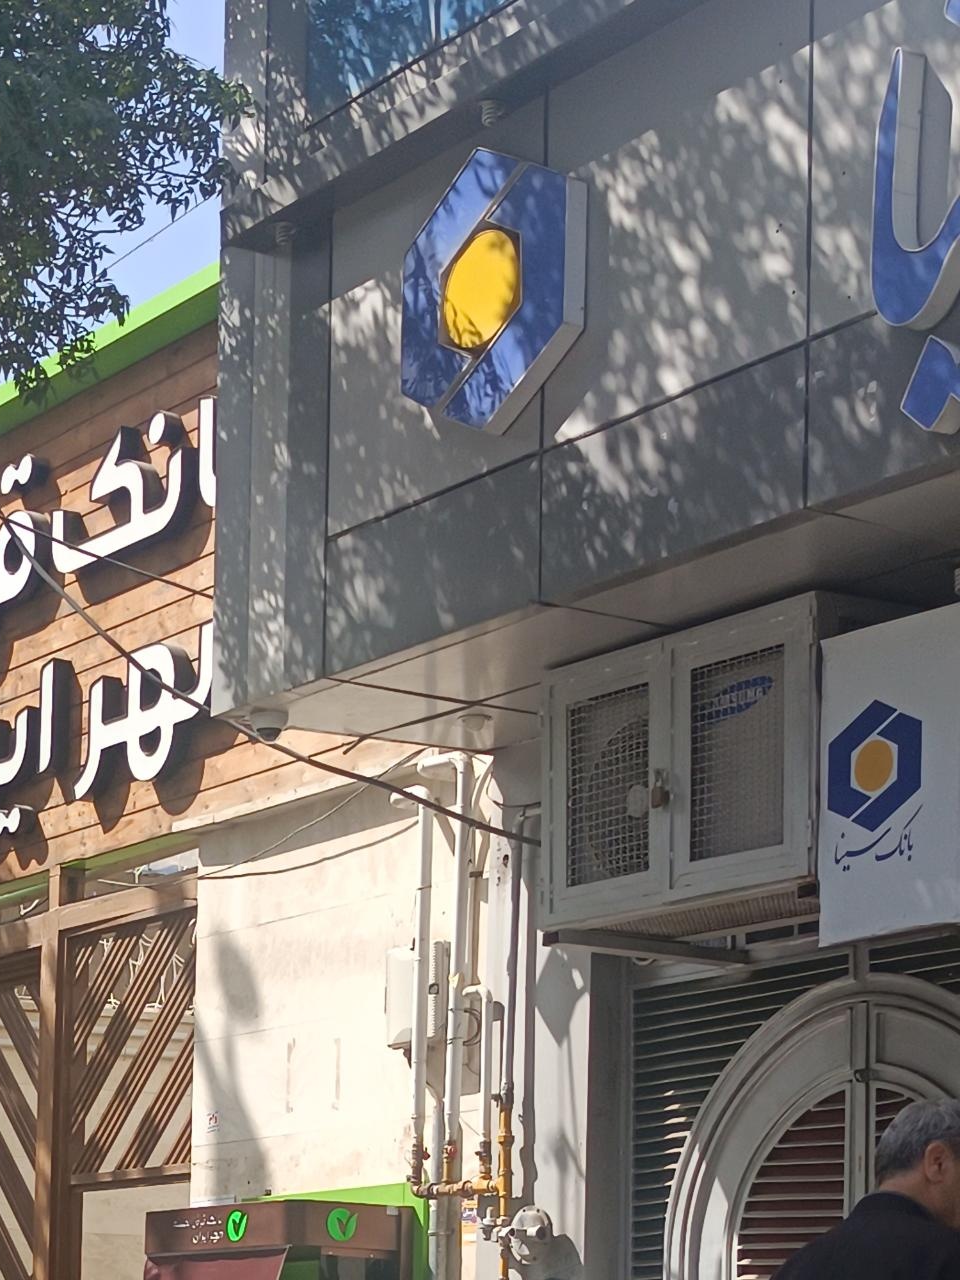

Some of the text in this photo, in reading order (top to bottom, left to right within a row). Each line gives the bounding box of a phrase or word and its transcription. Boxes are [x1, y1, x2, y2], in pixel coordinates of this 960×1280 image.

[52, 397, 216, 573] انک
[834, 804, 923, 872] بانک سینا
